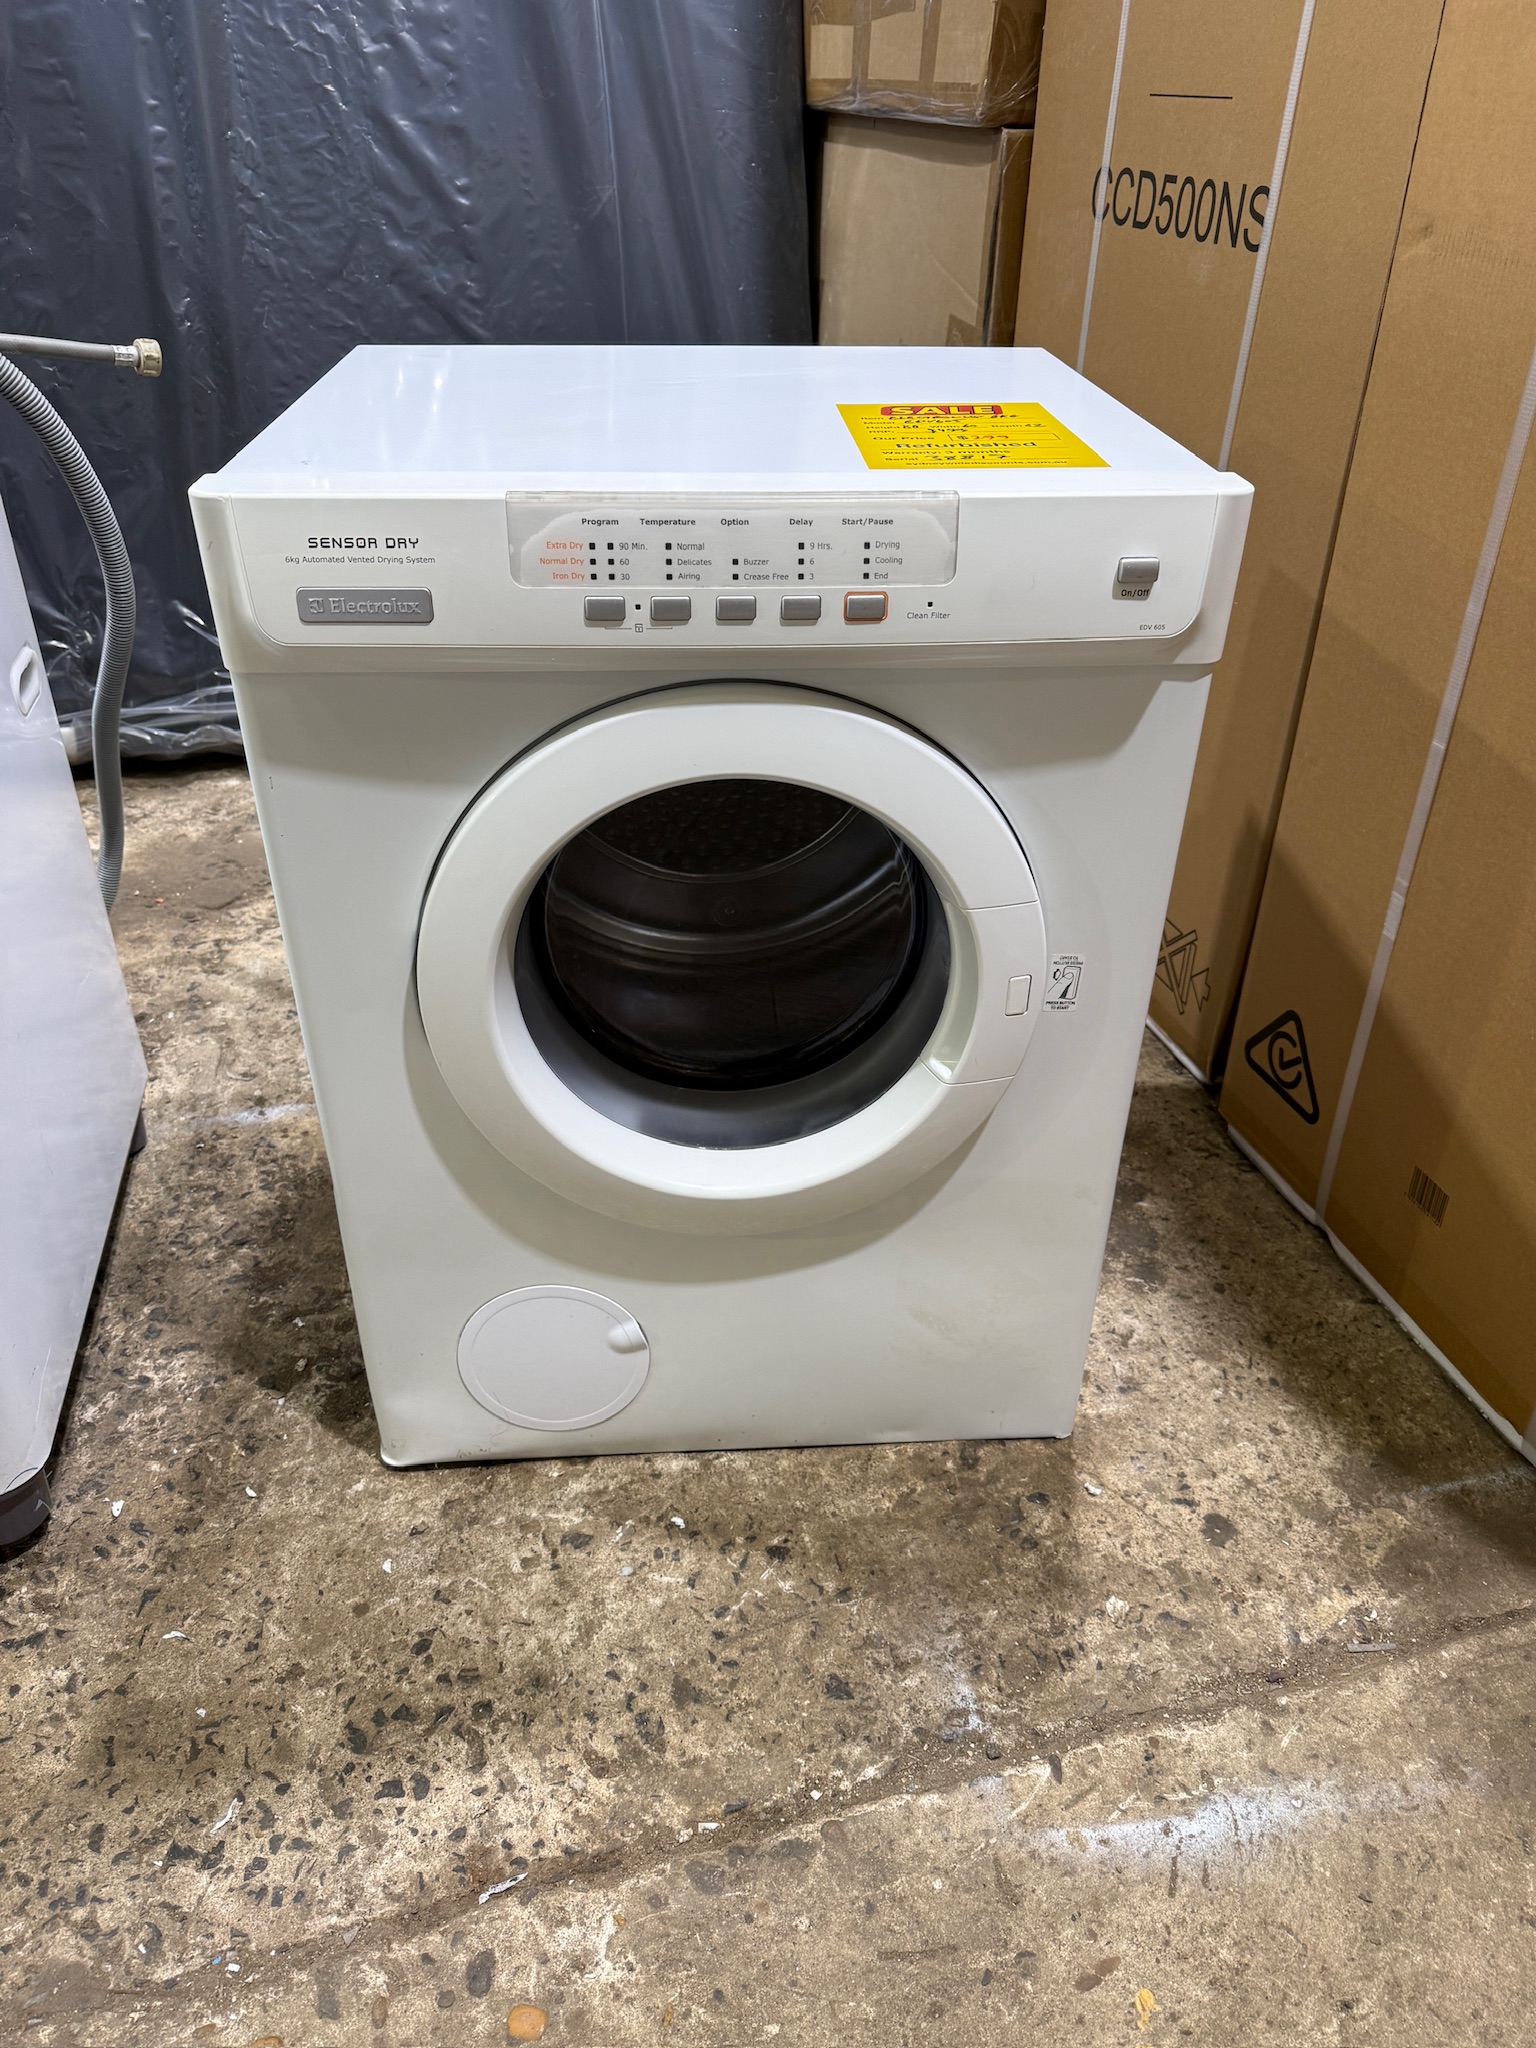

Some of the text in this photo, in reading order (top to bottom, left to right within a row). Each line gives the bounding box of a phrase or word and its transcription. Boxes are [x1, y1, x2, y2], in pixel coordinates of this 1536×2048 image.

[1092, 167, 1270, 253] CCD500NS
[889, 405, 996, 416] SALE
[896, 441, 1037, 449] Refurbished
[581, 518, 619, 527] Program
[639, 518, 696, 526] Temperature
[720, 518, 750, 526] Option
[789, 518, 813, 526] Delay
[841, 518, 894, 526] Start/Pause
[308, 537, 419, 549] SENSOR DRY
[546, 541, 584, 552] Extra Dry
[618, 542, 648, 551] 90 Min.
[676, 542, 705, 551] Normal
[809, 542, 833, 550] 9 Hrs.
[875, 541, 900, 550] Drying
[285, 556, 300, 565] 6kg
[377, 556, 404, 565] Drying
[405, 556, 436, 565] System
[539, 557, 585, 567] Normal Dry
[619, 558, 630, 566] 60
[677, 558, 712, 566] Delicates
[743, 558, 769, 566] Buzzer
[874, 556, 903, 565] Cooling
[552, 572, 586, 581] Iron Dry
[620, 573, 631, 581] 30
[677, 572, 701, 581] Airing
[743, 573, 789, 581] Crease Free
[874, 572, 889, 580] End
[1120, 588, 1150, 598] On/Off
[328, 597, 421, 614] Electrolux
[906, 611, 951, 620] Clean Filter
